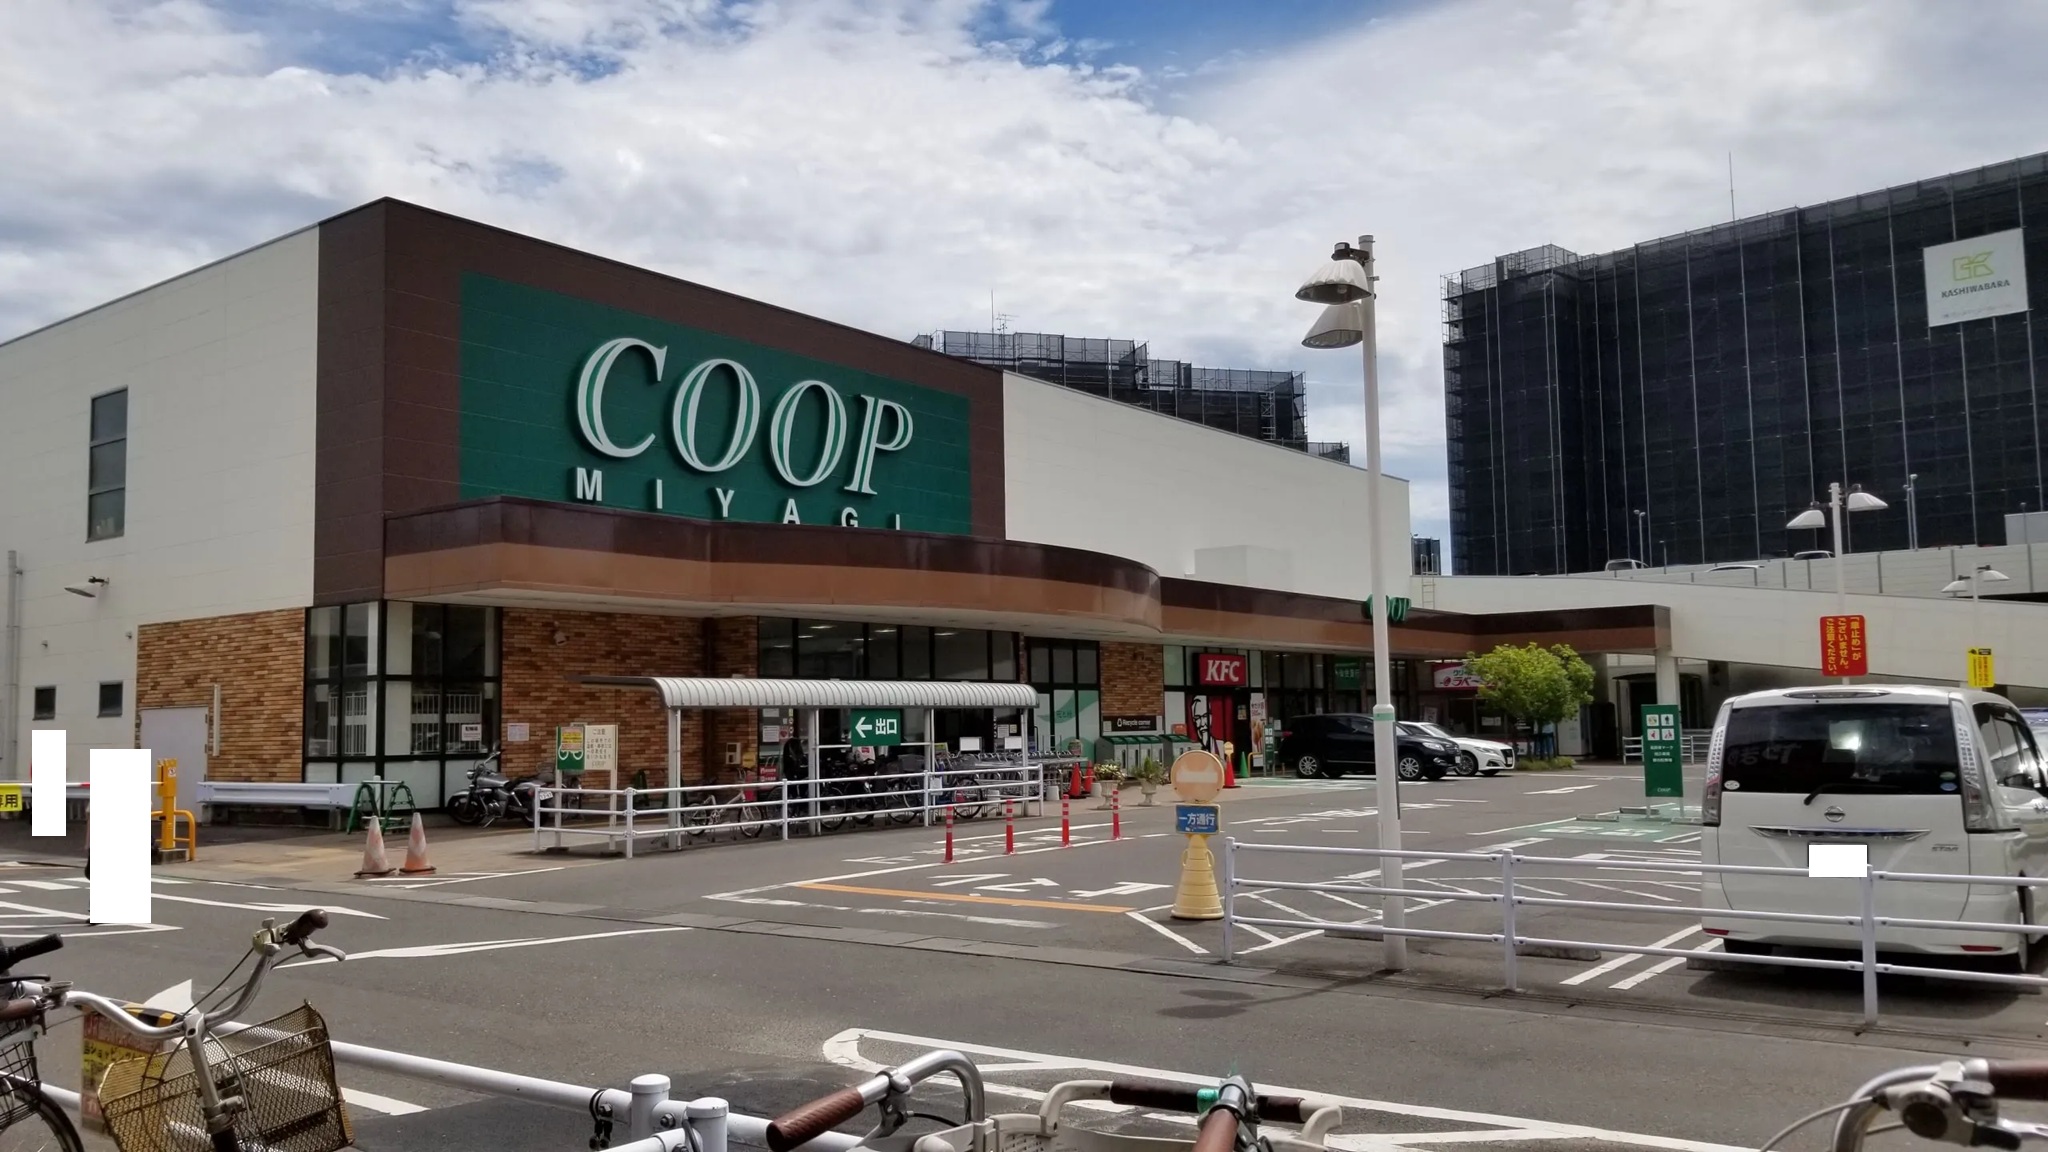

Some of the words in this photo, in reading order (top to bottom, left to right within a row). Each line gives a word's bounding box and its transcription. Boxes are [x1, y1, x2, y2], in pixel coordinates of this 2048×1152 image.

[1941, 279, 2011, 298] KASHIWABARA
[577, 337, 914, 495] COOP
[576, 466, 901, 531] MIYAGI
[1205, 659, 1241, 683] KFC
[875, 717, 898, 735] 出口
[1179, 813, 1216, 826] 一方通行
